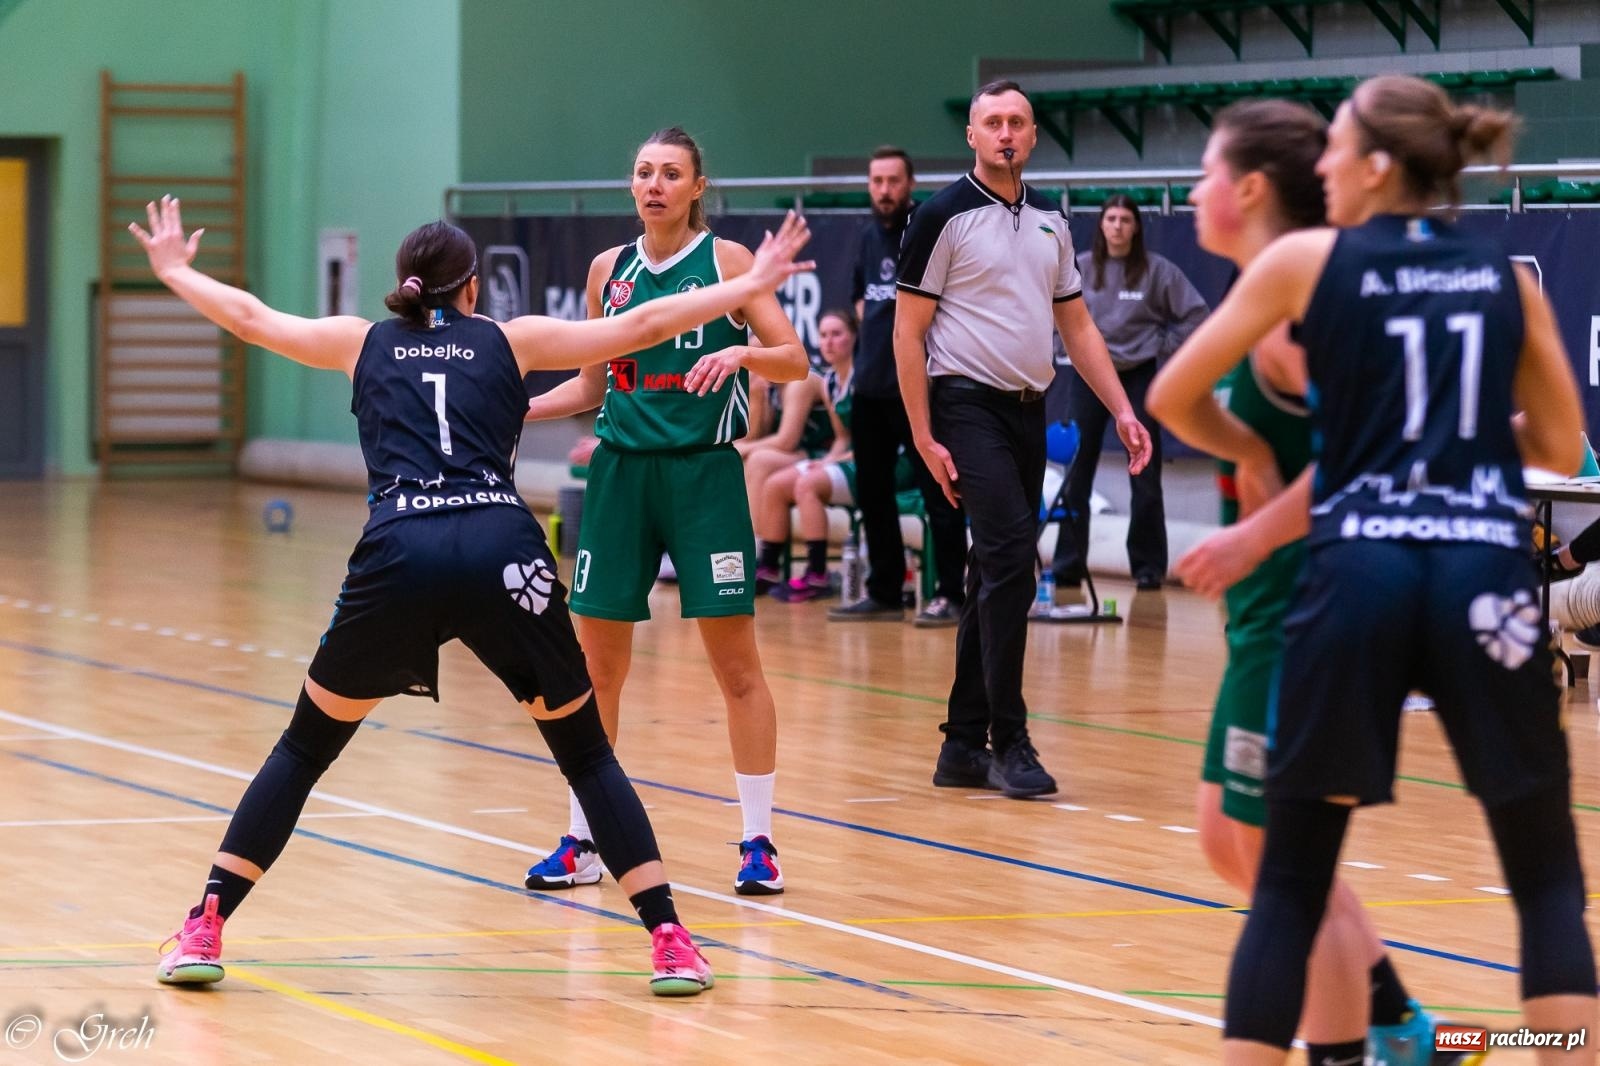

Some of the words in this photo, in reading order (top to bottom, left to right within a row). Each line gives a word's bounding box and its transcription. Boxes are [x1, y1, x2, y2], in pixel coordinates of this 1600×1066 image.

[393, 344, 475, 361] Dobejko
[1385, 313, 1485, 441] 11
[422, 372, 453, 456] 1
